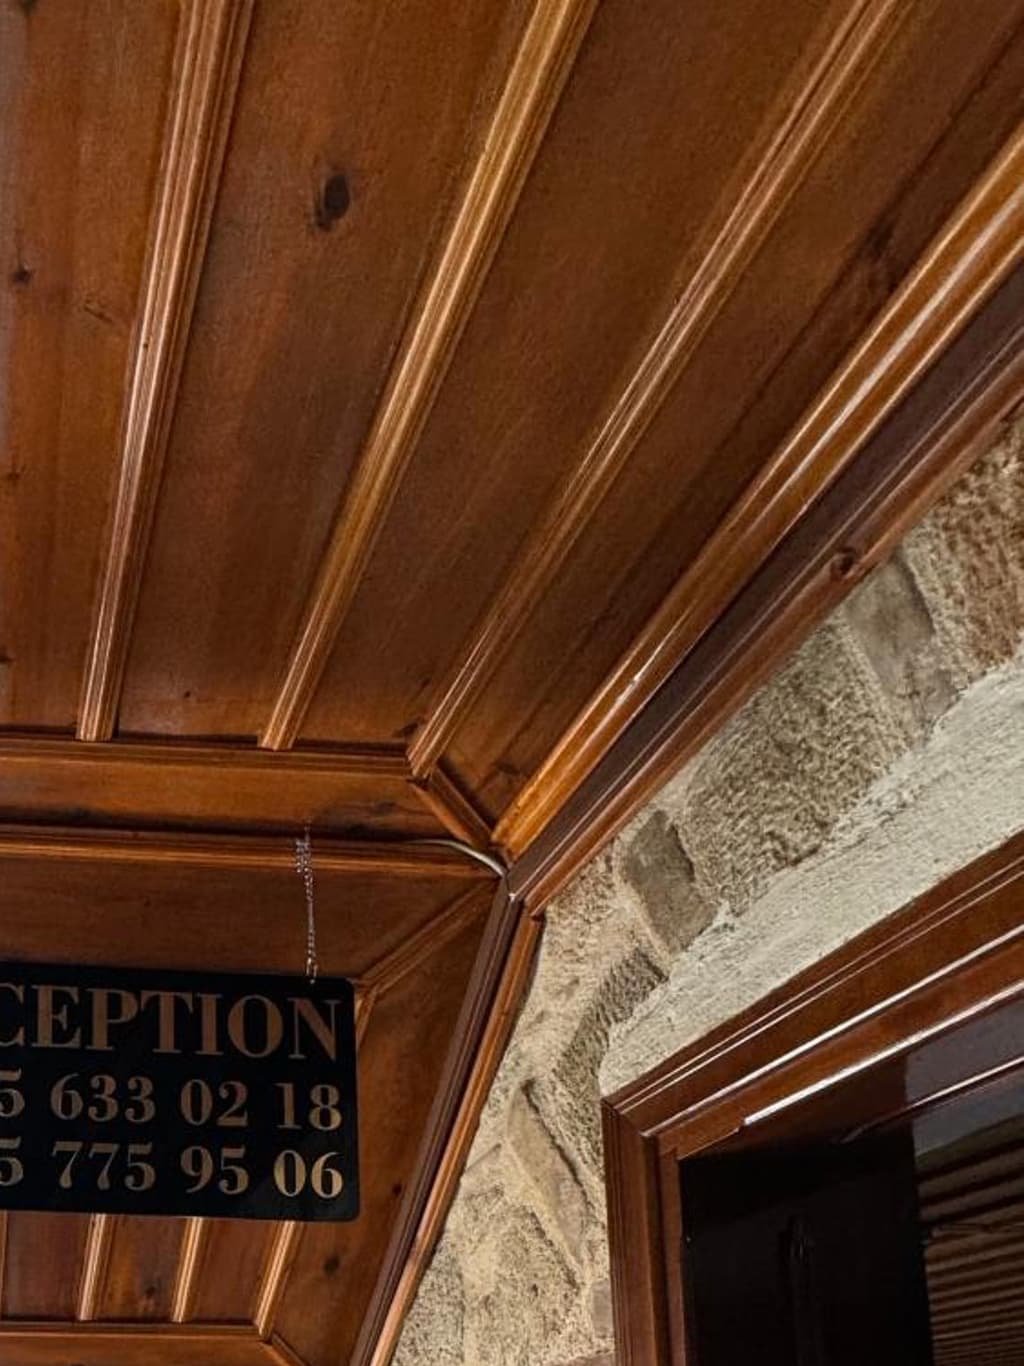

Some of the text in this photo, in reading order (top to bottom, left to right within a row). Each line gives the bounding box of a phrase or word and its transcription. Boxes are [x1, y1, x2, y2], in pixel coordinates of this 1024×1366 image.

[51, 1072, 156, 1122] 633
[180, 1079, 248, 1127] 02
[275, 1083, 341, 1130] 18
[52, 1142, 156, 1191] 775
[180, 1146, 248, 1195] 95
[274, 1150, 343, 1198] 06
